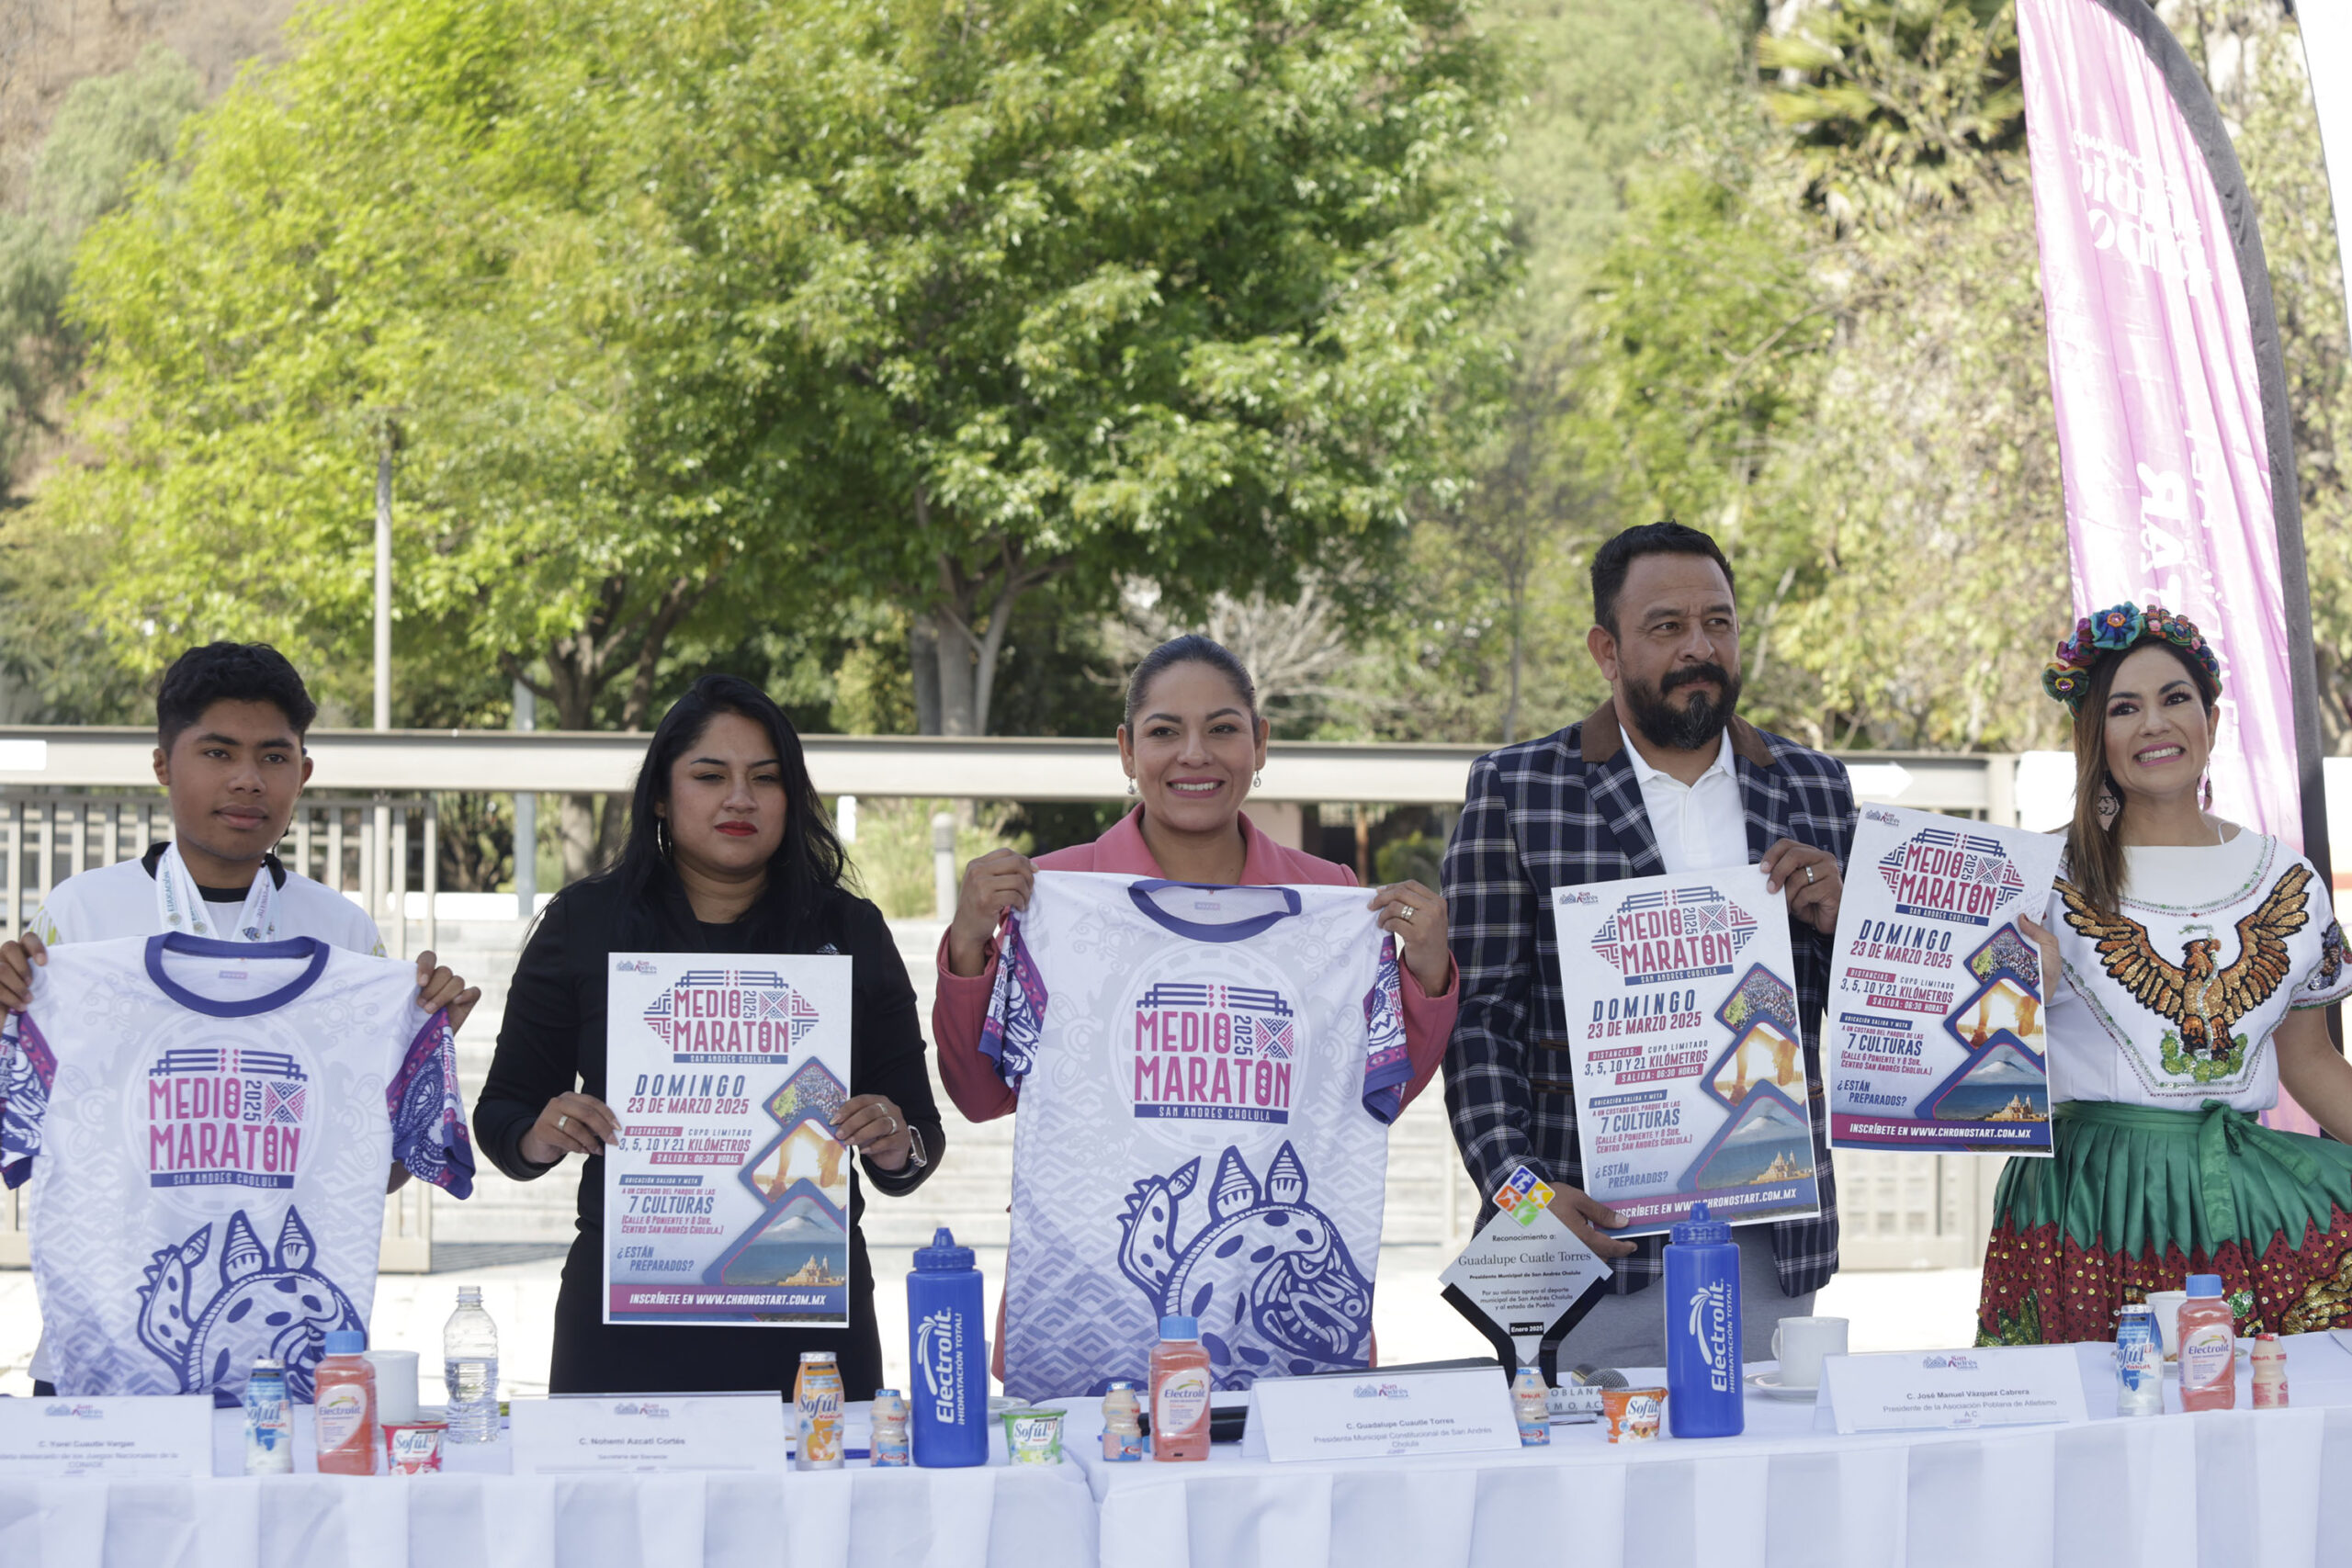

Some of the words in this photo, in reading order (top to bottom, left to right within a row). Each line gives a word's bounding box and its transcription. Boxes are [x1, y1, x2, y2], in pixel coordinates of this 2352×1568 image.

[1905, 844, 1964, 878] MEDIO
[1961, 853, 1978, 881] 2025
[1896, 873, 1997, 917] MARATÓN
[1617, 908, 1683, 943] MEDIO
[1683, 907, 1699, 935] 2025
[1859, 919, 1952, 953] DOMINGO
[1621, 930, 1733, 976] MARATÓN
[1850, 941, 1866, 957] 23
[1868, 943, 1883, 959] DE
[1883, 945, 1921, 964] MARZO
[1923, 951, 1952, 969] 2025
[1849, 969, 1892, 982] DISTANCIAS:
[1900, 976, 1918, 985] CUPO
[1921, 979, 1954, 989] LIMITADO
[674, 990, 741, 1018] MEDIO
[1840, 978, 1849, 991] 3,
[1852, 979, 1860, 993] 5,
[1863, 981, 1875, 993] 10
[1878, 983, 1883, 994] Y
[1885, 984, 1896, 996] 21
[1899, 987, 1953, 1003] KILÓMETROS
[743, 991, 756, 1019] 2025
[1593, 988, 1695, 1023] DOMINGO
[1872, 997, 1902, 1008] SALIDA:
[1905, 1000, 1922, 1010] 06:30
[1924, 1003, 1943, 1012] HORAS
[673, 1016, 788, 1053] MARATÓN
[1136, 1011, 1231, 1054] MEDIO
[1234, 1015, 1252, 1055] 2025
[1588, 1022, 1602, 1040] 23
[1607, 1021, 1621, 1037] DE
[1625, 1015, 1665, 1035] MARZO
[1670, 1010, 1701, 1030] 2025
[1848, 1033, 1856, 1049] 7
[1859, 1034, 1922, 1055] CULTURAS
[635, 1075, 746, 1097] DOMINGO
[1135, 1054, 1291, 1107] MARATÓN
[149, 1077, 241, 1120] MEDIO
[243, 1080, 262, 1122] 2025
[627, 1098, 644, 1113] 23
[648, 1098, 663, 1113] DE
[667, 1098, 711, 1114] MARZO
[715, 1099, 749, 1114] 2025
[1849, 1092, 1906, 1107] PREPARADOS?
[1159, 1106, 1179, 1117] SAN
[1227, 1108, 1270, 1122] CHOLULA
[1601, 1116, 1608, 1134] 7
[1613, 1107, 1679, 1133] CULTURAS
[1849, 1122, 1895, 1135] INSCRÍBETE
[1898, 1126, 1907, 1135] EN
[1911, 1127, 2030, 1138] WWW.CHRONOSTART.COM.MX
[150, 1118, 300, 1172] MARATÓN
[174, 1174, 190, 1185] SAN
[236, 1173, 277, 1187] CHOLULA
[1610, 1170, 1668, 1189] PREPARADOS?
[628, 1196, 638, 1213] 7
[641, 1196, 714, 1213] CULTURAS
[1663, 1202, 1672, 1213] EN
[630, 1260, 694, 1271] PREPARADOS?
[1458, 1254, 1516, 1266] Guadalupe
[1520, 1252, 1555, 1263] Cuatle
[1558, 1251, 1591, 1262] Torres
[630, 1292, 680, 1304] INSCRÍBETE
[683, 1294, 694, 1304] EN
[696, 1294, 825, 1305] WWW.CHRONOSTART.COM.MX
[1710, 1280, 1727, 1393] Electrolit
[2188, 1343, 2230, 1355] Electrolit
[934, 1310, 955, 1424] Electrolit
[1164, 1389, 1205, 1398] Electrolit
[1357, 1420, 1397, 1429] Guadalupe
